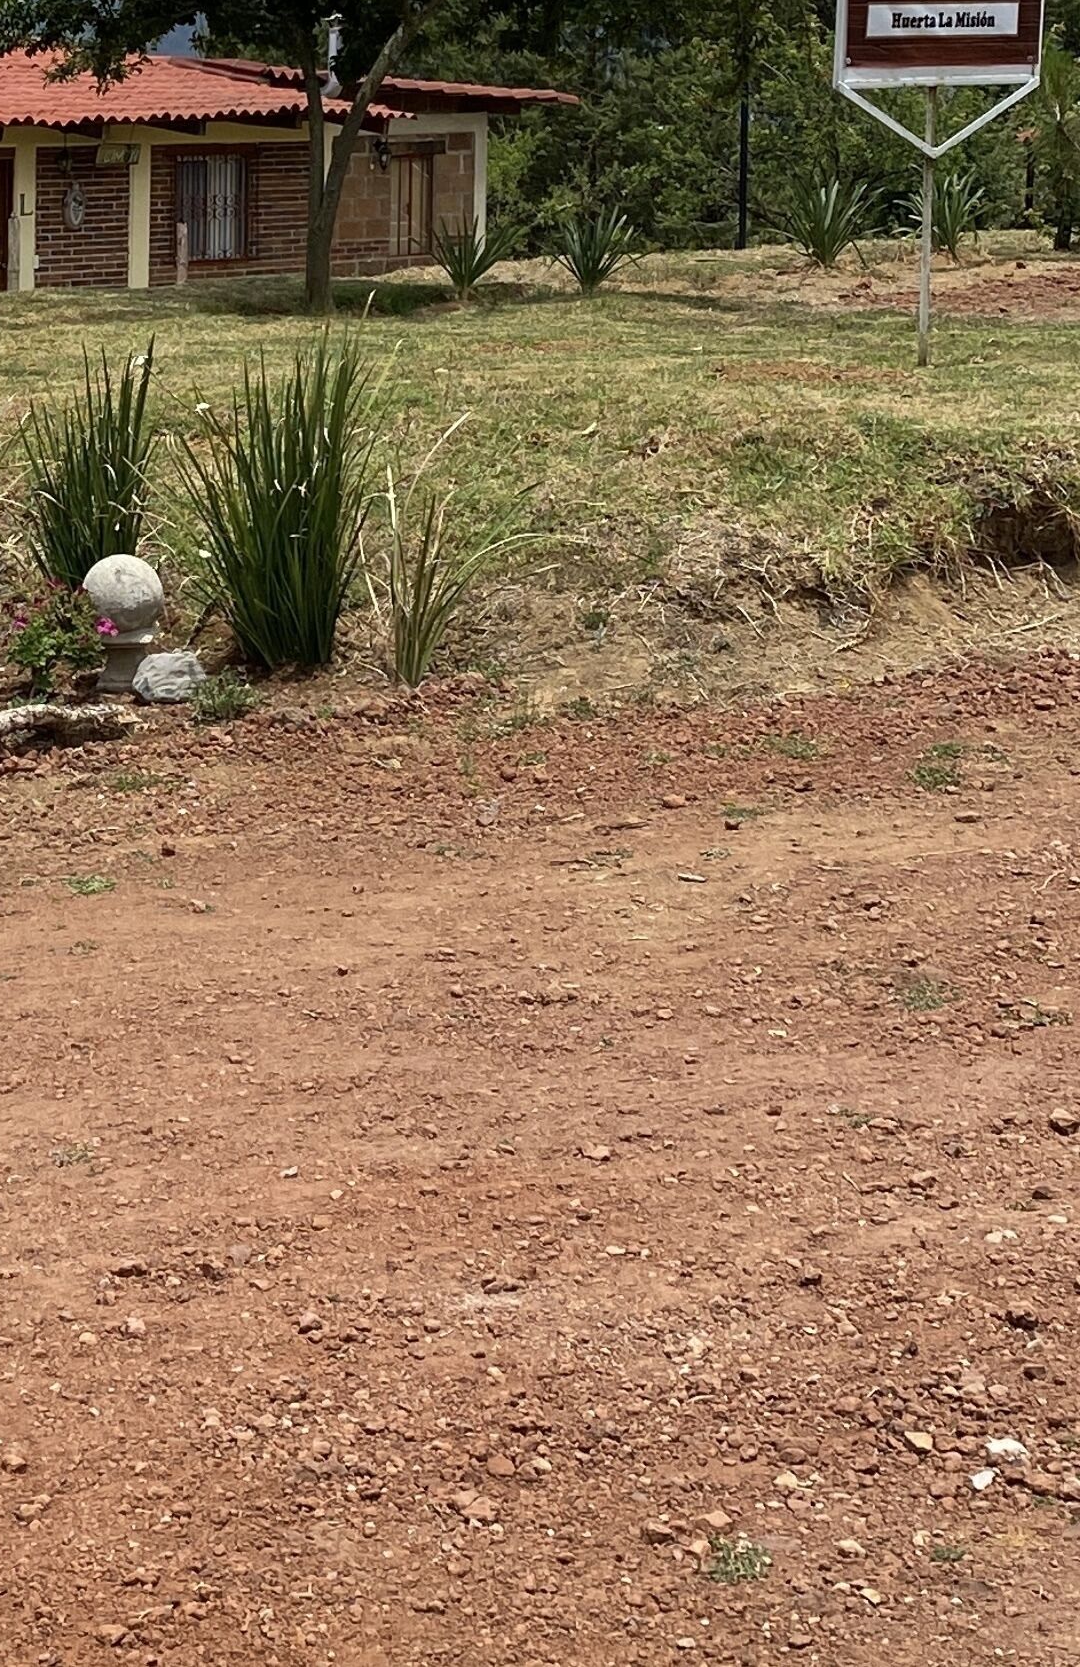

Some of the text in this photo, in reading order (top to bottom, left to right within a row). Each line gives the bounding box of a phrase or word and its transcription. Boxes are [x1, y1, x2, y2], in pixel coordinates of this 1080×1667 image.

[891, 11, 995, 29] Huerta La Misión
[20, 193, 33, 216] L
